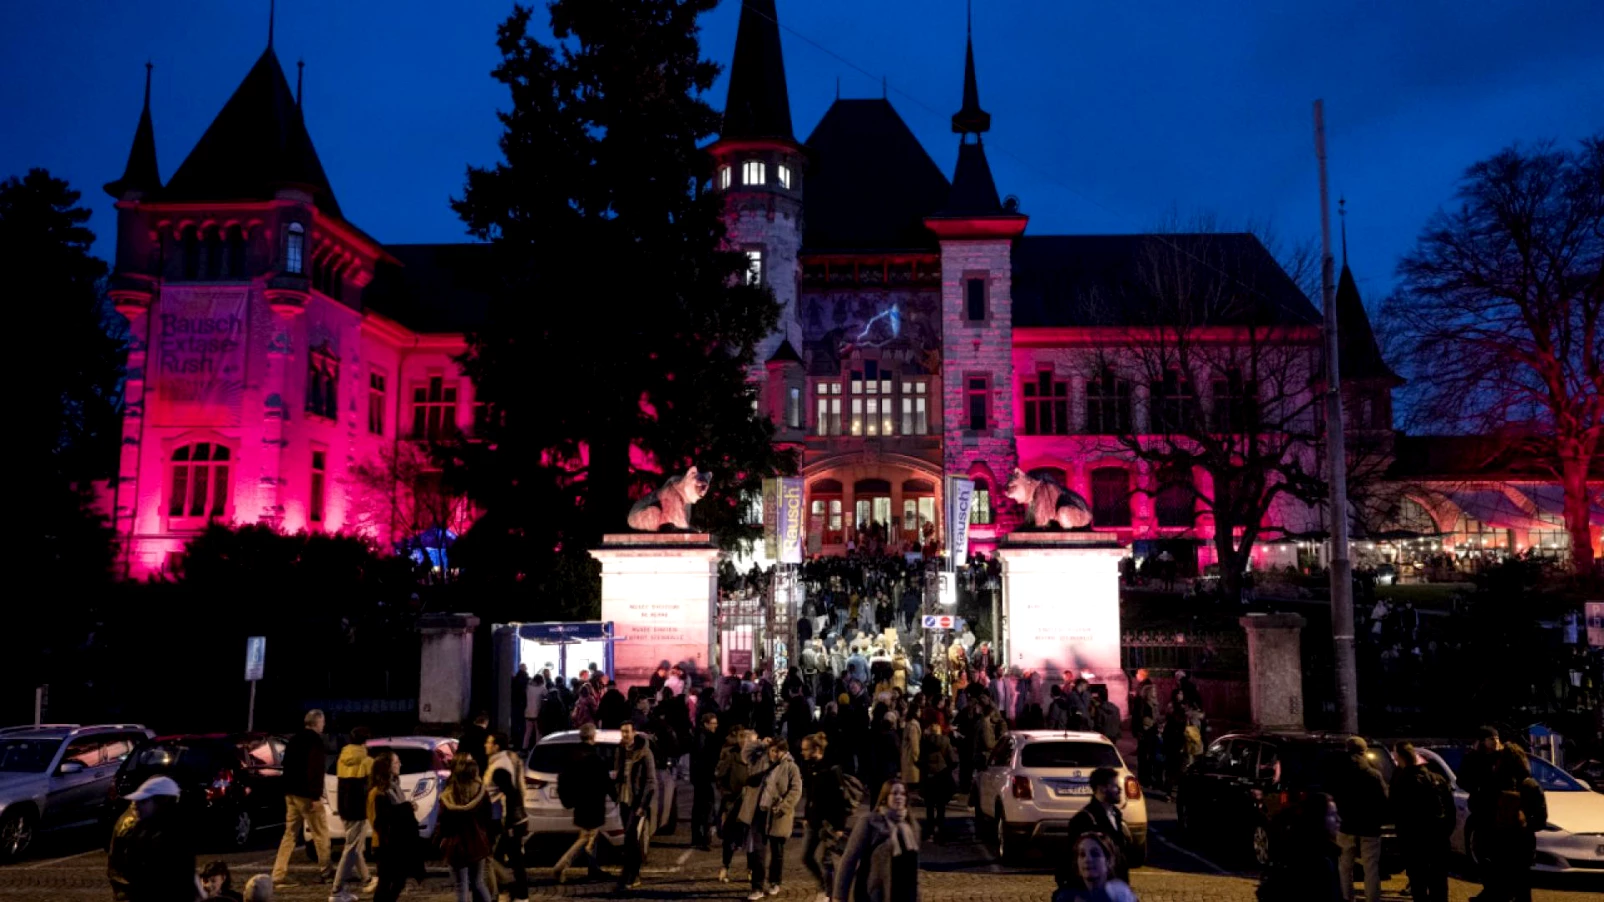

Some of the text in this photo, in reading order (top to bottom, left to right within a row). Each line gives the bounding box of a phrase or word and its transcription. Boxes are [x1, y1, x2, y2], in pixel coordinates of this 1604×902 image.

[161, 313, 242, 335] Rausch
[161, 352, 213, 374] Rush
[783, 487, 800, 551] Rausch
[956, 490, 970, 553] Rausch
